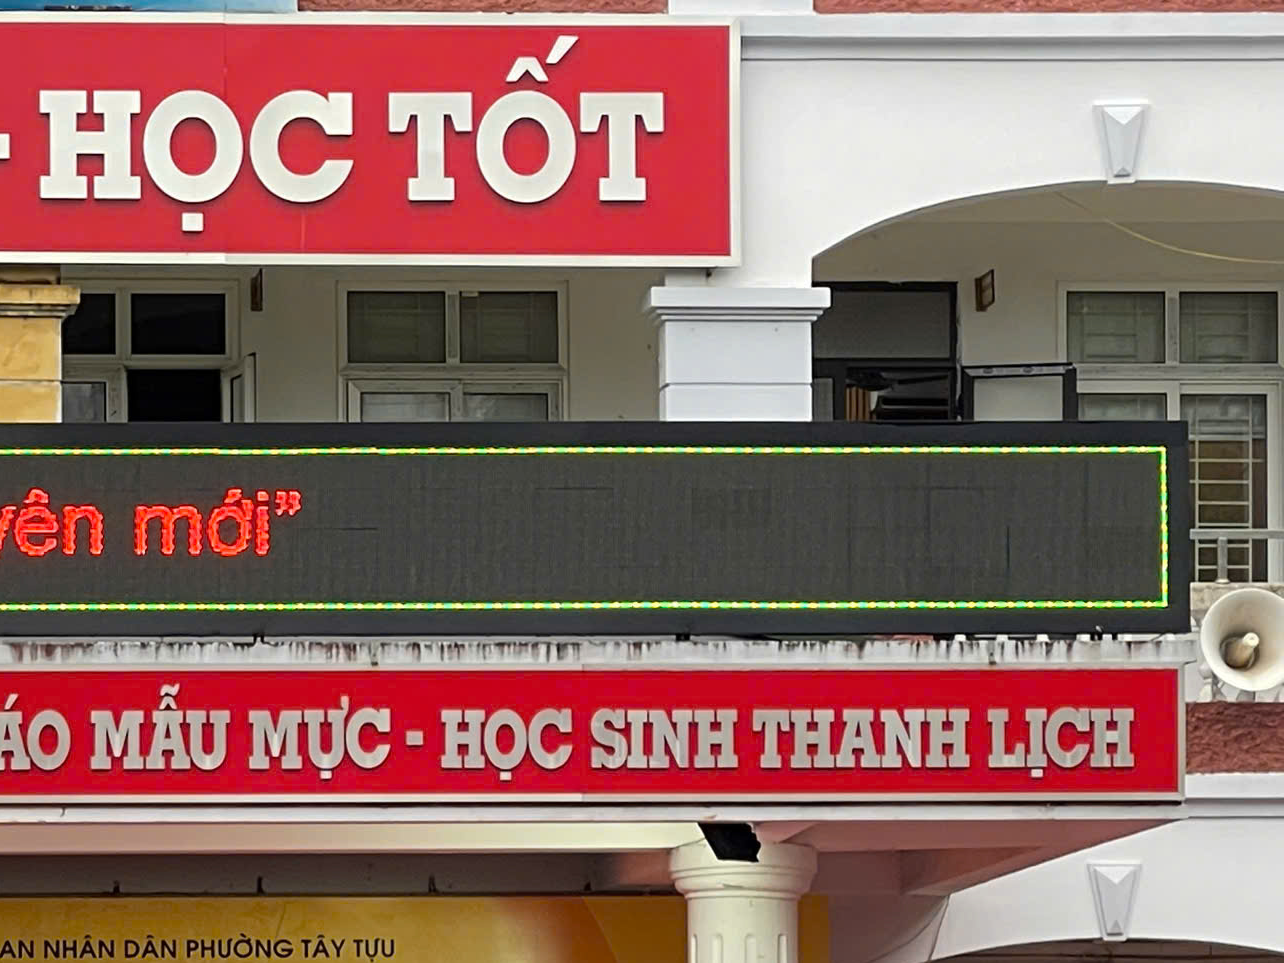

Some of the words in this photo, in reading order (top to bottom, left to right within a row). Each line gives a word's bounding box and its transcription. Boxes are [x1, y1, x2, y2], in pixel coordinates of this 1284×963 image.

[40, 89, 355, 233] HỌC
[389, 36, 666, 204] TỐT
[90, 685, 231, 772] MẪU
[249, 697, 392, 780] MỰC
[441, 708, 574, 783] HỌC
[590, 707, 740, 771] SINH
[752, 708, 972, 770] THANH
[987, 707, 1136, 780] LỊCH
[43, 934, 115, 959] NHÂN
[124, 934, 177, 959] DÂN
[186, 932, 294, 959] PHƯỜNG
[300, 934, 346, 959] TÂY
[352, 938, 396, 962] TỰU
